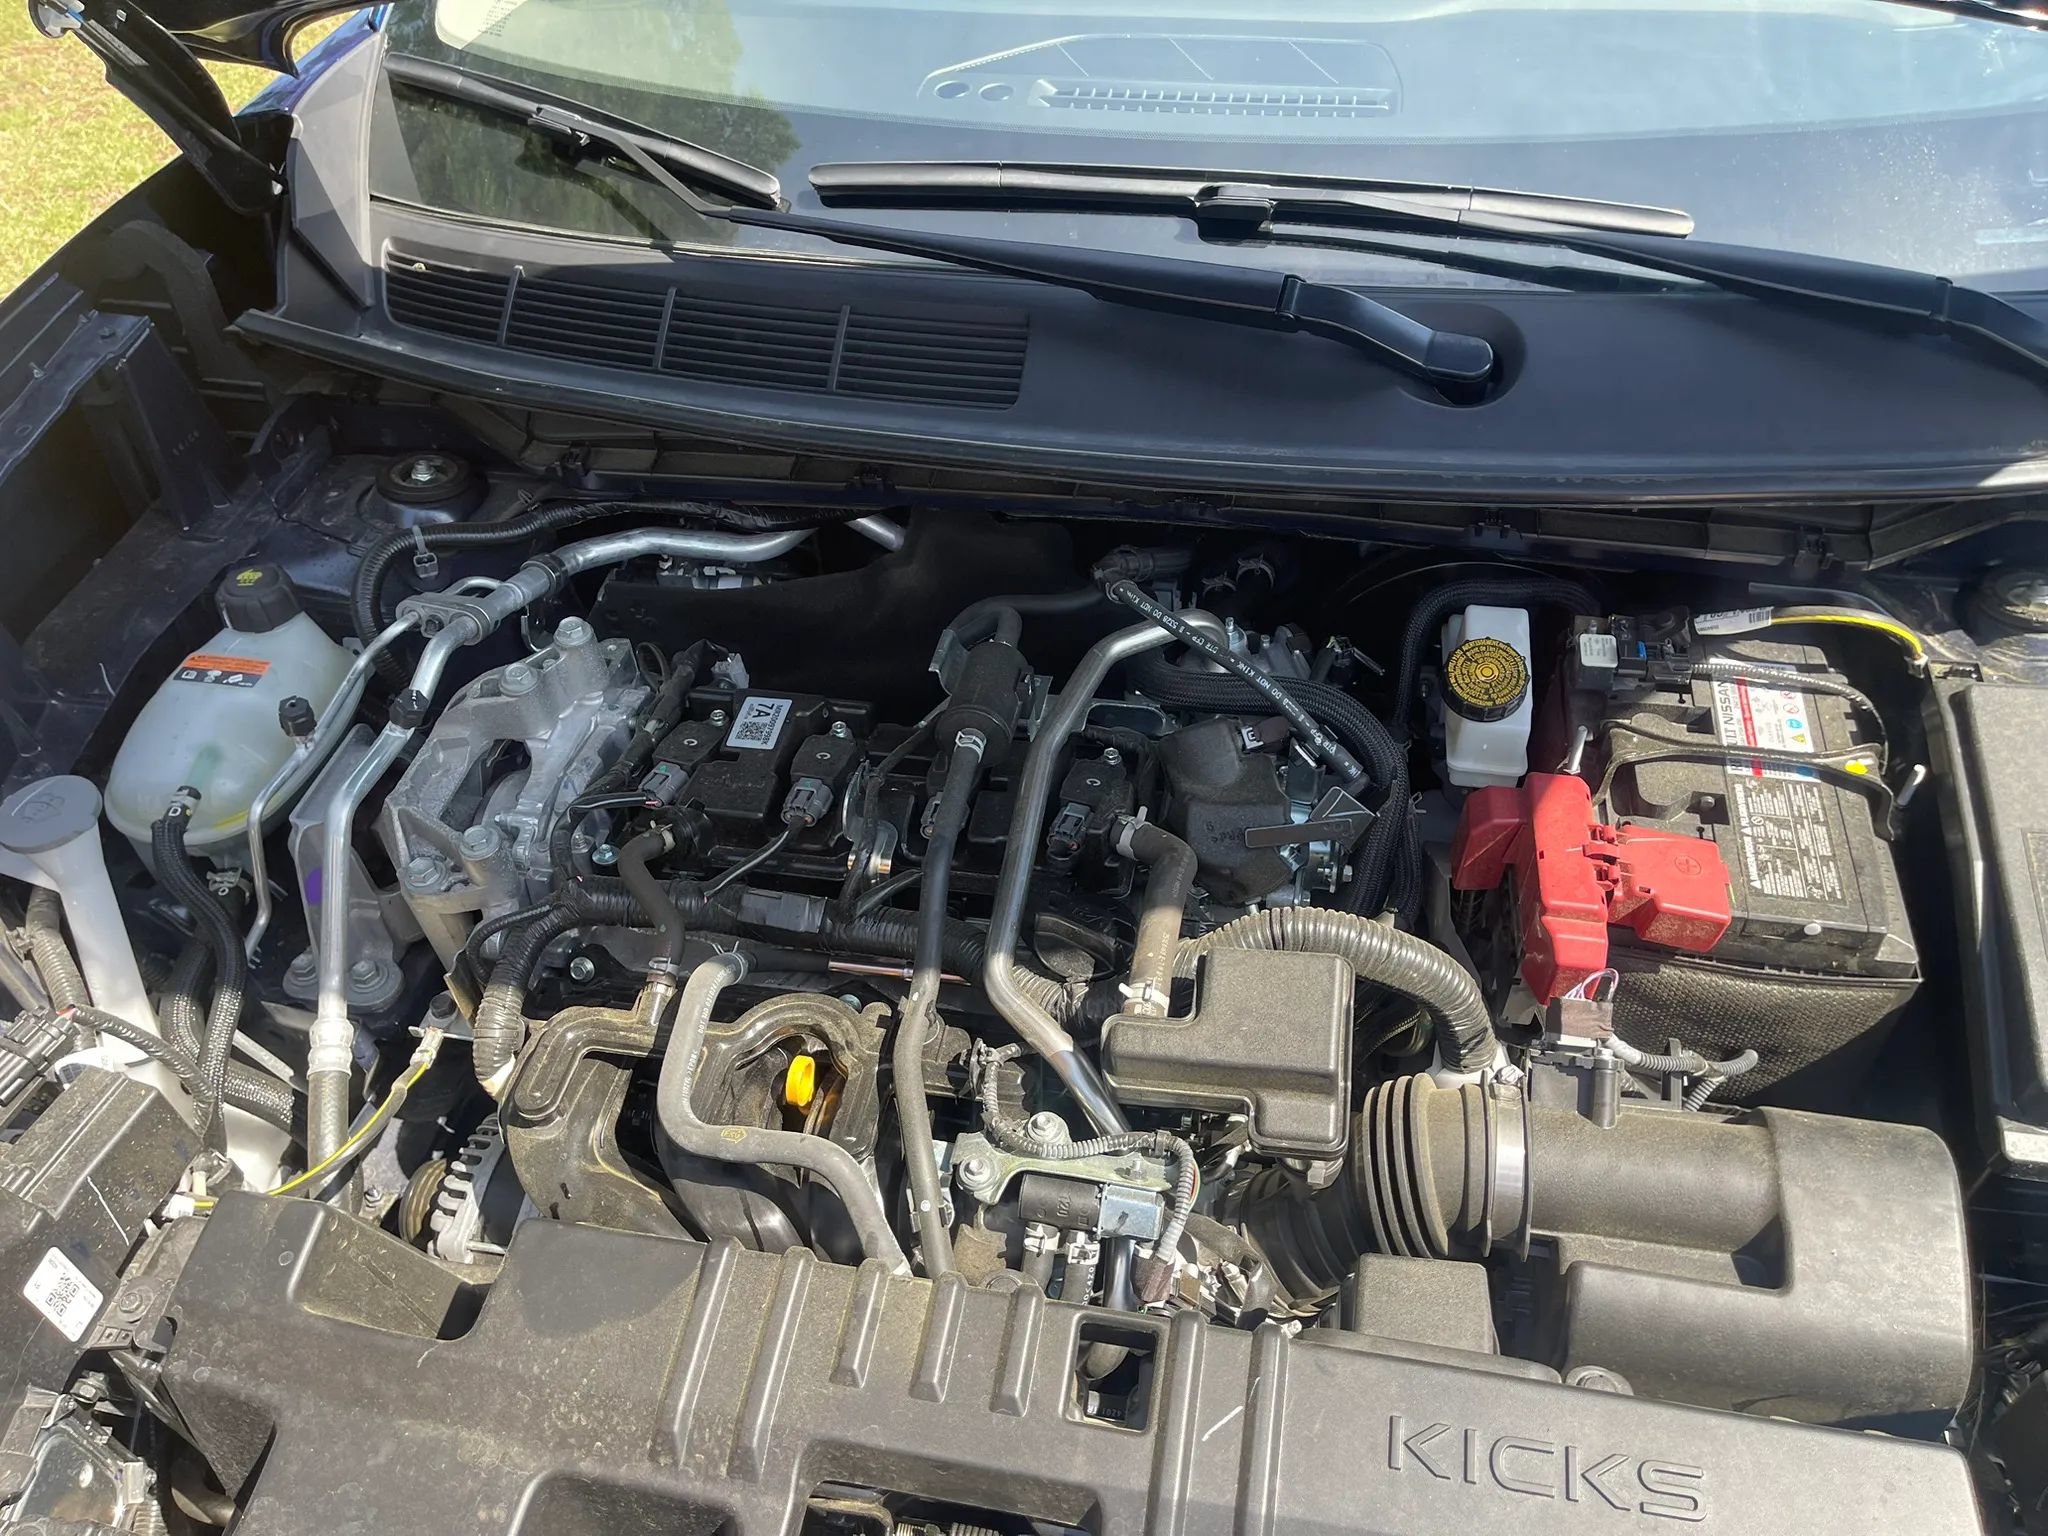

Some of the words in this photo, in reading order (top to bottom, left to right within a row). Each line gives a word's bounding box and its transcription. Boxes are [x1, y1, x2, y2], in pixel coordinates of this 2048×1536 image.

[1140, 601, 1153, 613] NOT
[1256, 676, 1271, 690] NOT
[753, 703, 775, 719] 7A
[168, 806, 182, 817] D
[1387, 1414, 1709, 1523] KICKS
